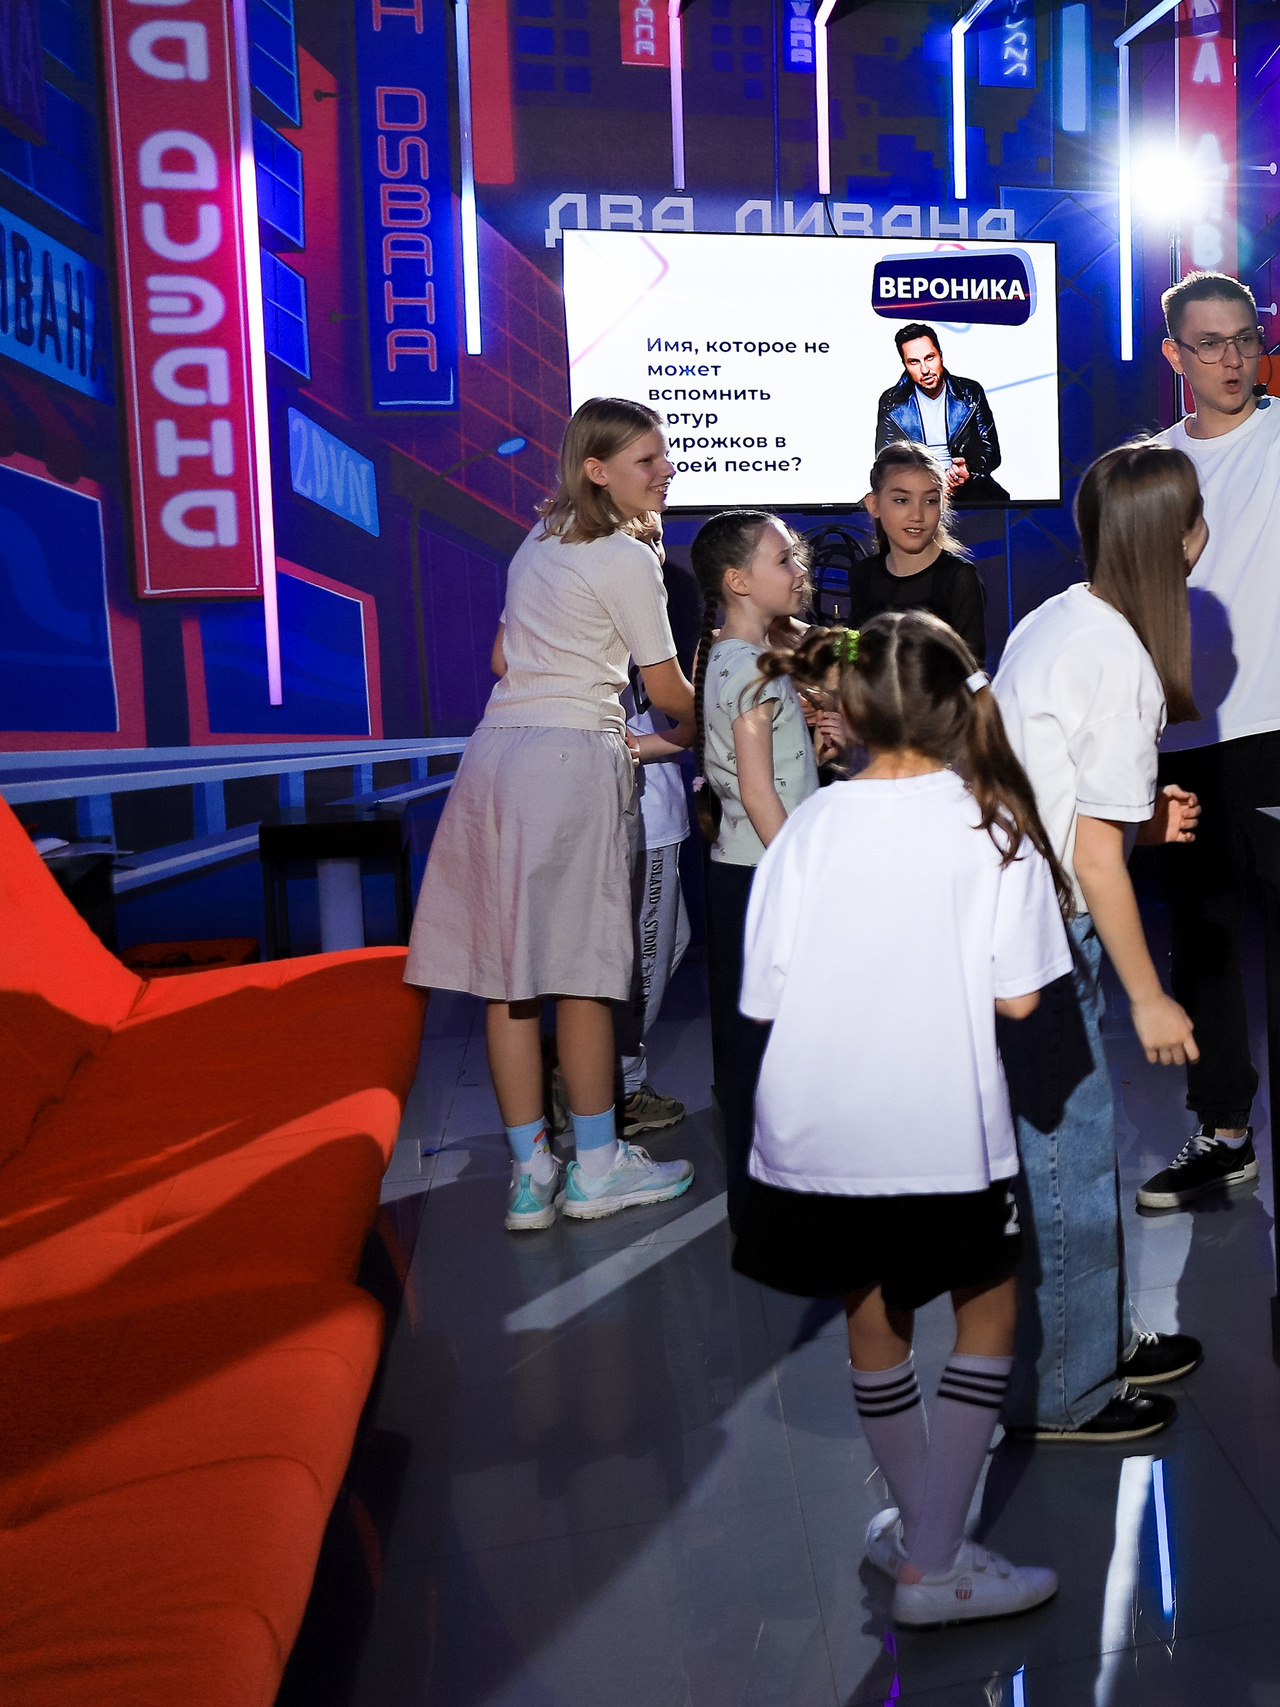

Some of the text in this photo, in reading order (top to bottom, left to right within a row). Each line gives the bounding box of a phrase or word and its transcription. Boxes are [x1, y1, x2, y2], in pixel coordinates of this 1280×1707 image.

[879, 276, 1026, 301] ВЕРОНИКА
[647, 337, 830, 357] Имя, которое не
[647, 364, 722, 377] может
[648, 388, 771, 401] вспомнить
[666, 412, 719, 428] ртур
[667, 436, 787, 452] ирожков в
[725, 456, 803, 472] песне?
[648, 858, 664, 905] ISLAND
[642, 919, 660, 960] STONE
